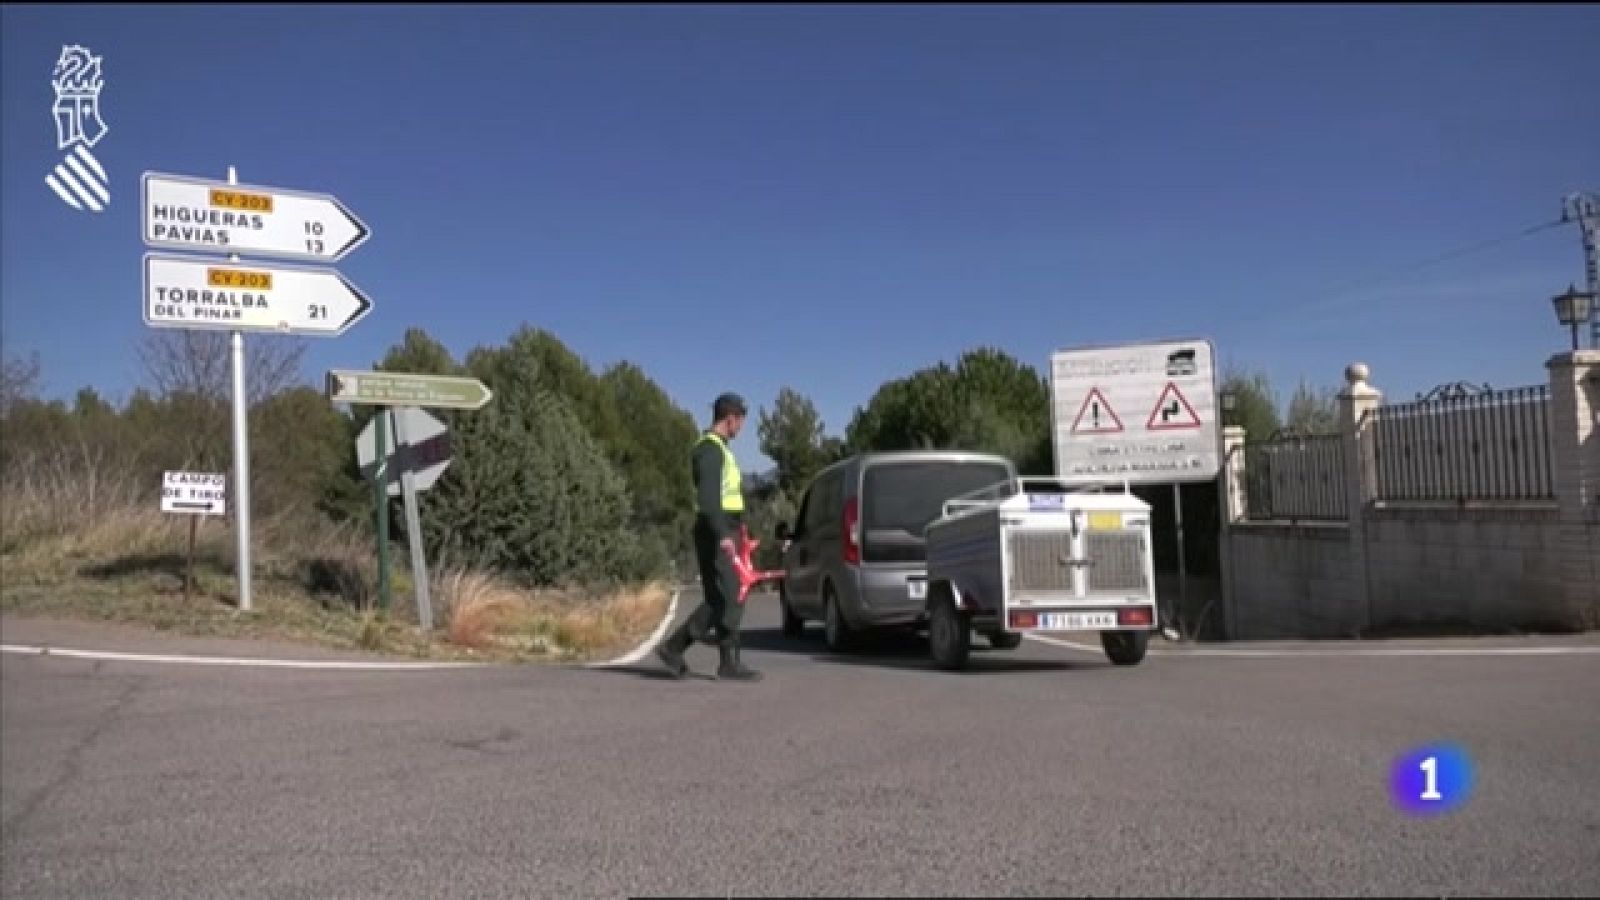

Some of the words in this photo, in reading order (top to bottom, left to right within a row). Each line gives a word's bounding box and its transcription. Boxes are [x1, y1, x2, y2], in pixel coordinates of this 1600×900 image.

[153, 204, 264, 230] HIGUERAS
[153, 225, 230, 244] PAVIAS
[304, 220, 324, 236] 10
[305, 239, 324, 254] 13
[156, 287, 269, 308] TORRALBA
[154, 306, 185, 318] DEL
[194, 307, 242, 319] PINAR
[307, 304, 328, 319] 21
[166, 473, 224, 486] CAMPO
[161, 487, 181, 498] DE
[189, 488, 225, 500] TIRO
